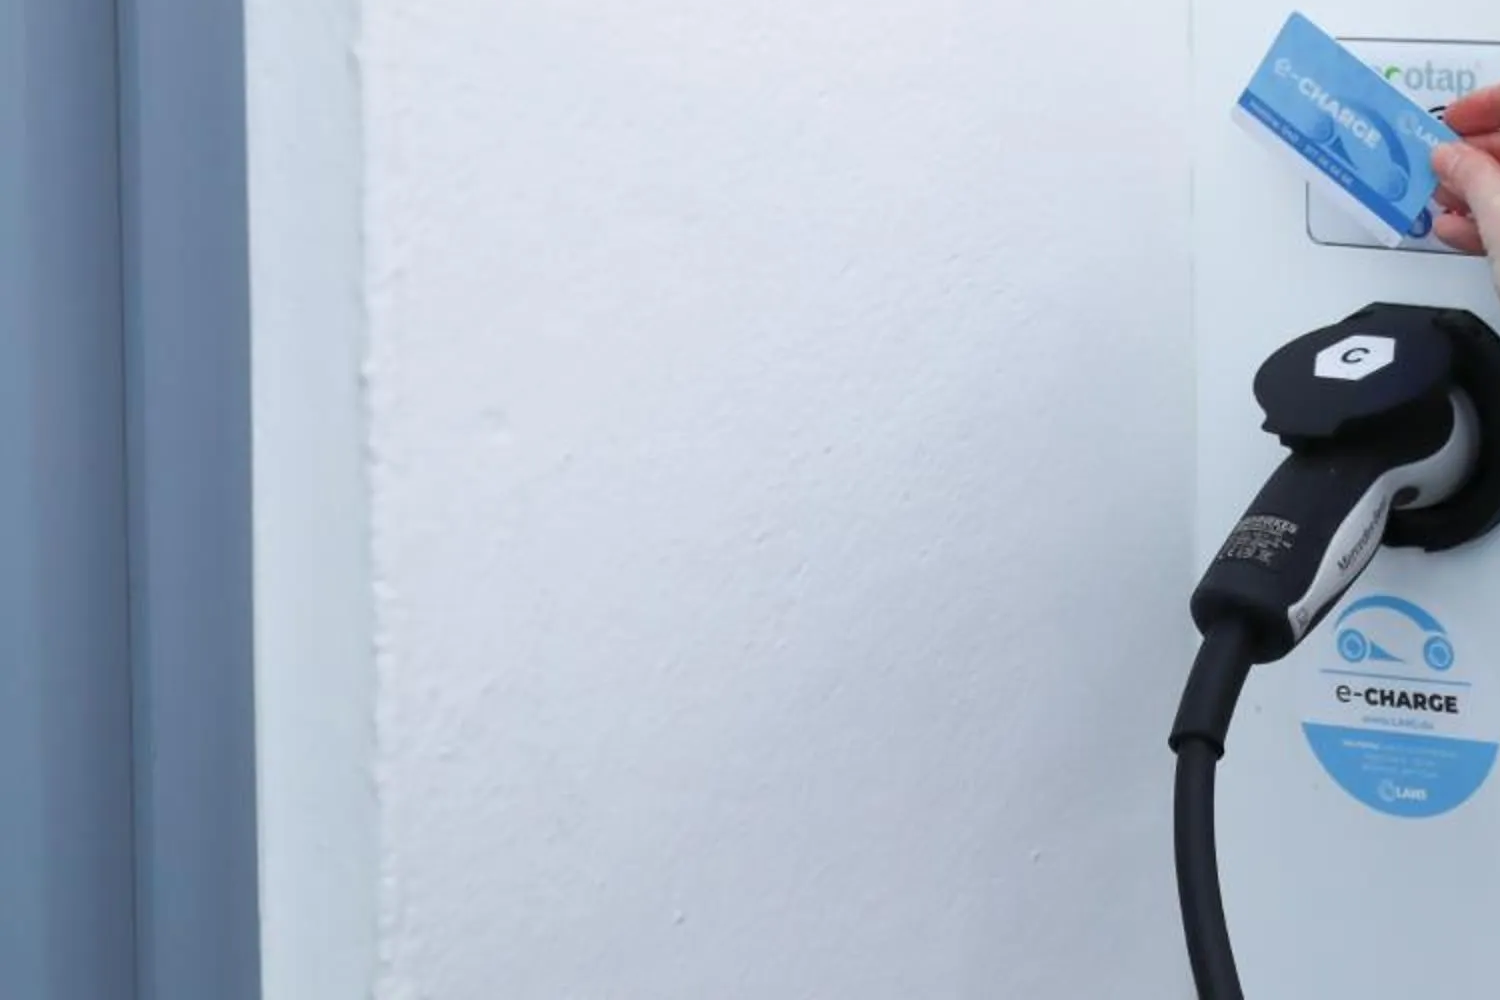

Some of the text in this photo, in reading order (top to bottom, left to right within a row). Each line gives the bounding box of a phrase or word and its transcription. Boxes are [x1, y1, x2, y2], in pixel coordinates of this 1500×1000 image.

[1274, 58, 1382, 150] e-CHARGE
[1340, 346, 1370, 365] C
[1335, 683, 1460, 715] e-CHARGE
